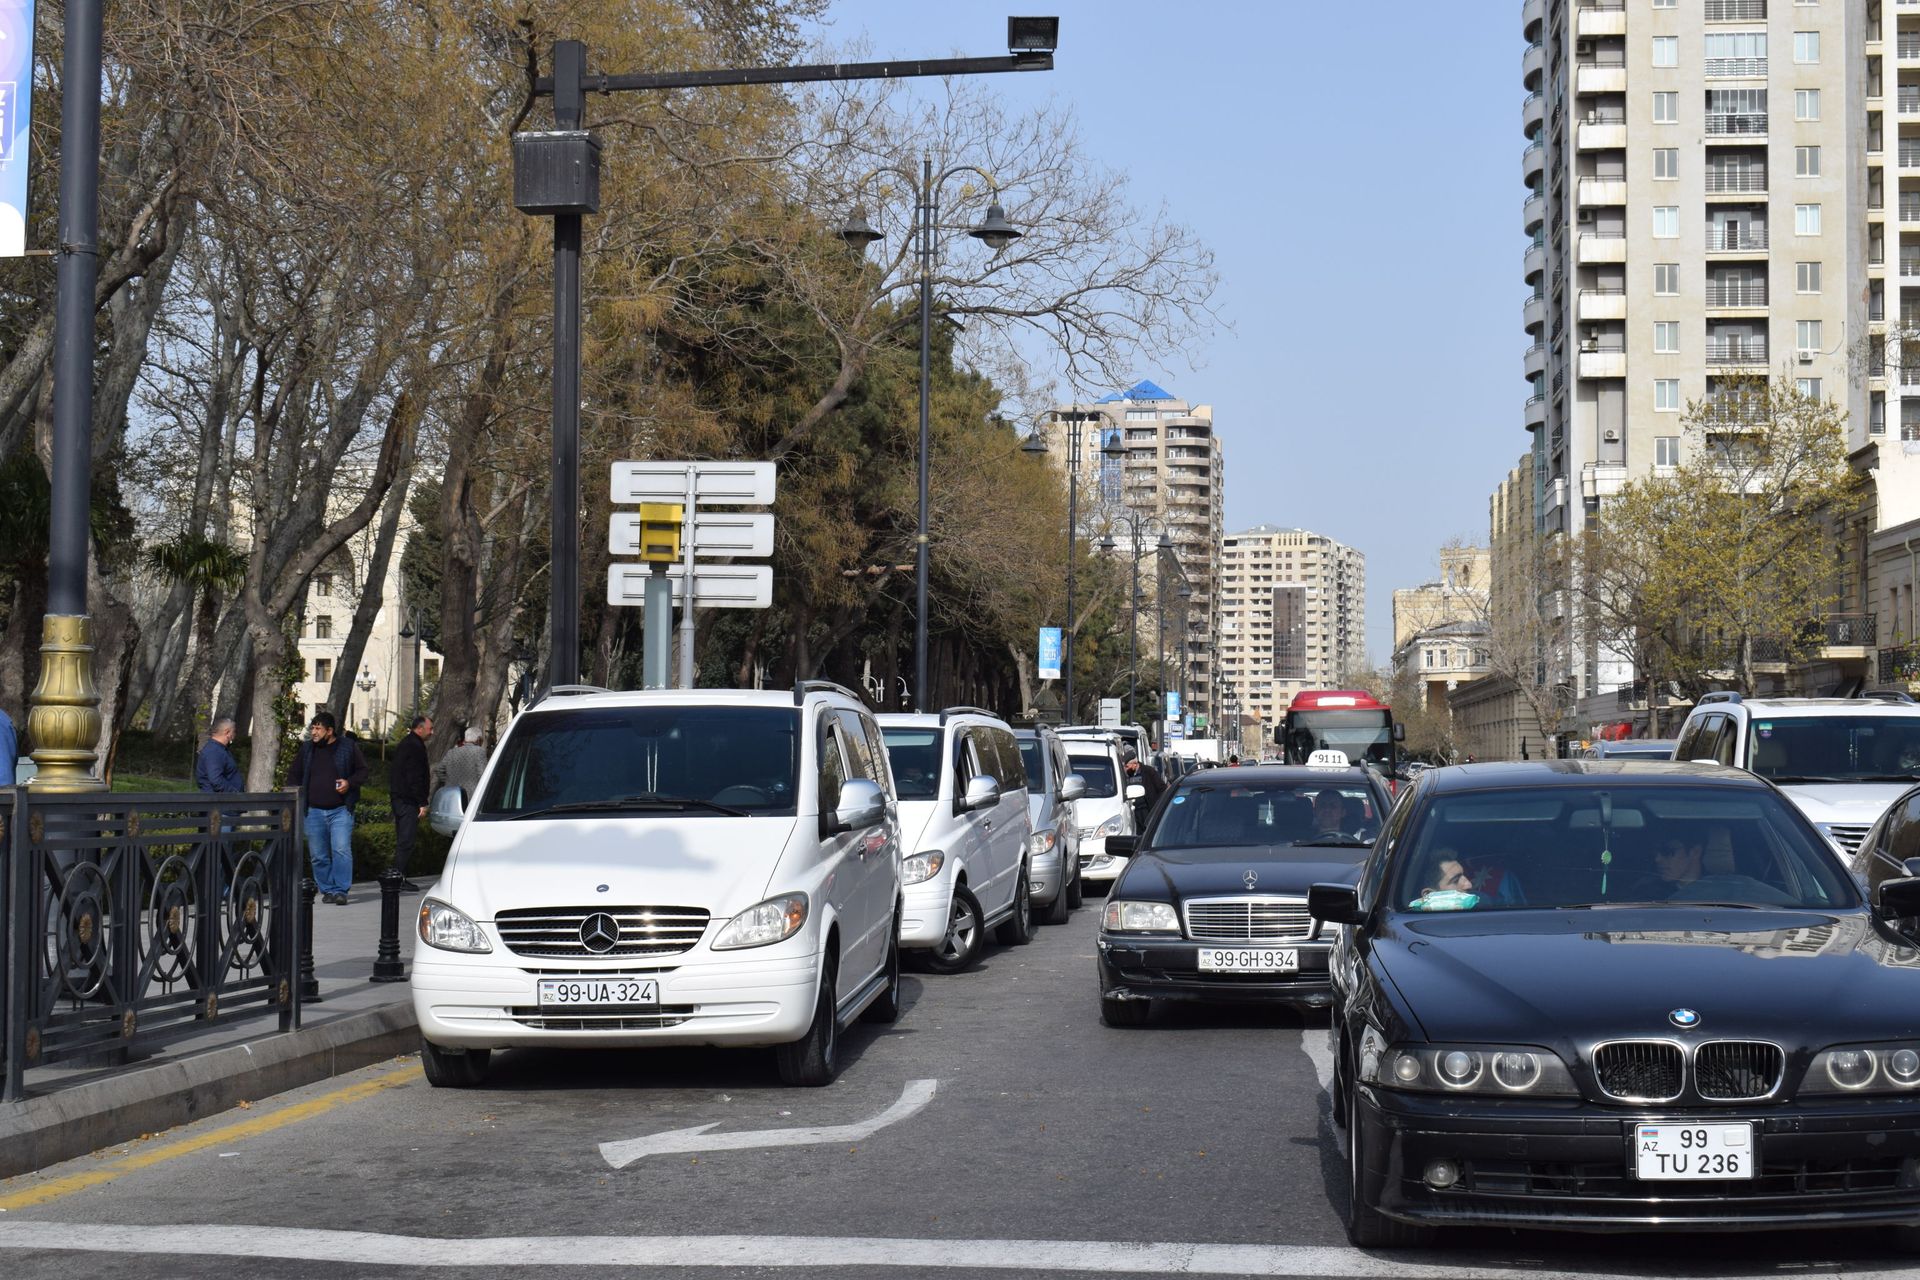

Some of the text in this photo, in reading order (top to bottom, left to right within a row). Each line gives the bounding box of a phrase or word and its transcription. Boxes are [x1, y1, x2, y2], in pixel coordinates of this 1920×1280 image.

[558, 983, 652, 1002] 99-UA-324
[1642, 1141, 1658, 1152] AZ
[1680, 1130, 1708, 1149] 99
[1656, 1154, 1739, 1174] TU 236
